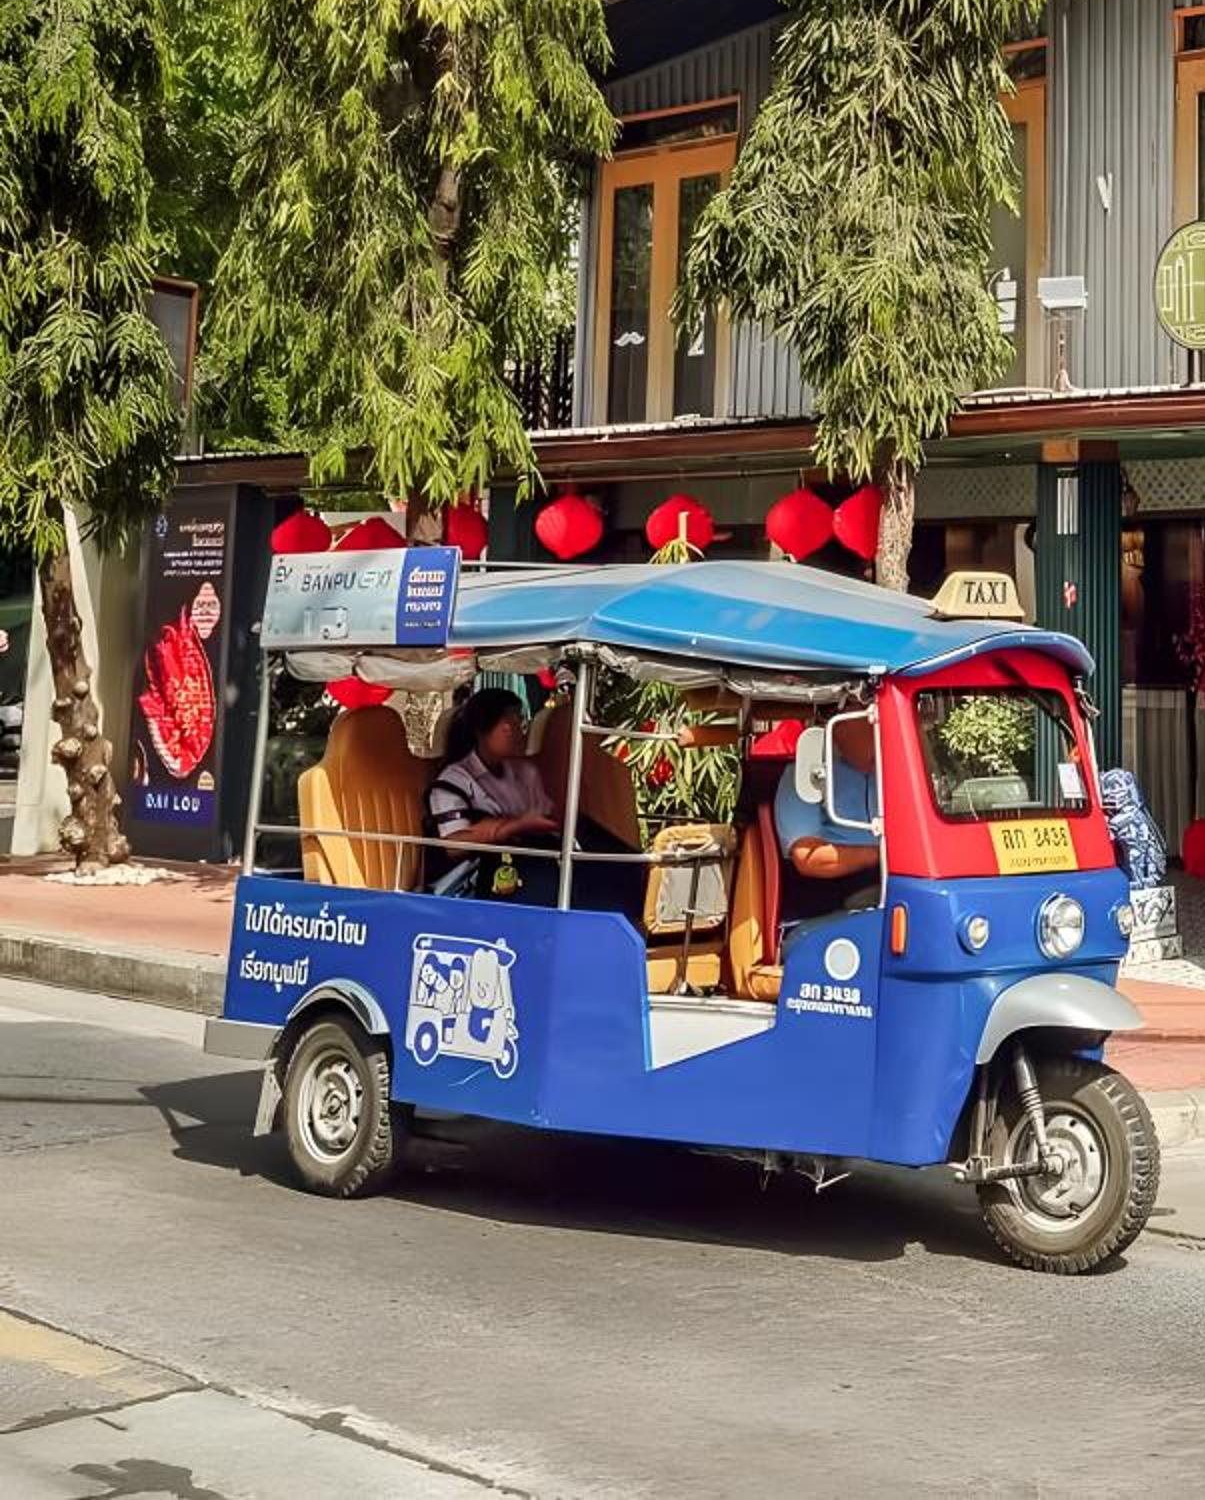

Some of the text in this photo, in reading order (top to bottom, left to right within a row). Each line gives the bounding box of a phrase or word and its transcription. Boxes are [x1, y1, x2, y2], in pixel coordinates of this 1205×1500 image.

[301, 571, 356, 593] BANPU
[963, 581, 1007, 605] TAXI
[173, 795, 201, 812] LOU
